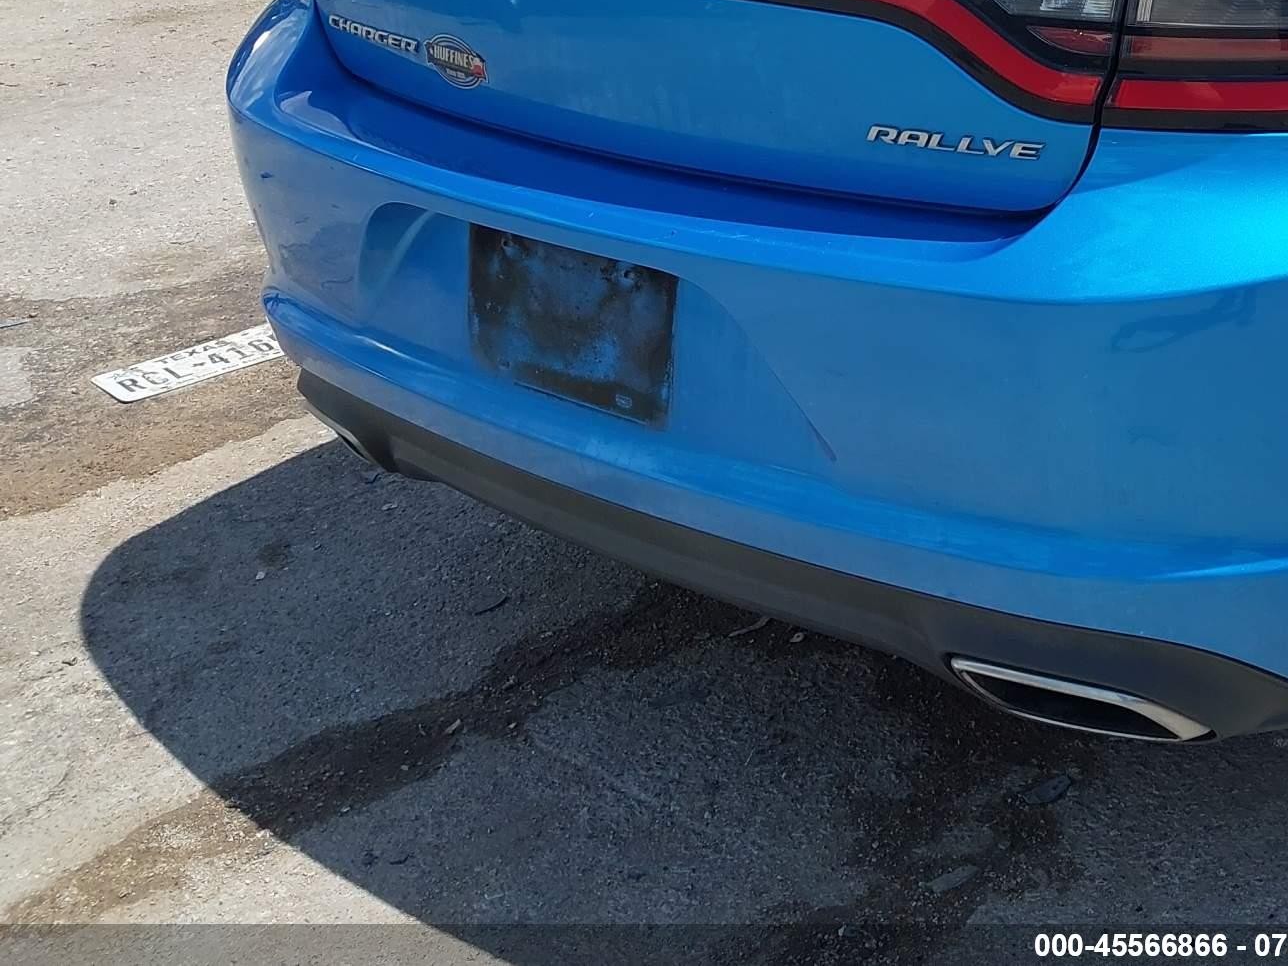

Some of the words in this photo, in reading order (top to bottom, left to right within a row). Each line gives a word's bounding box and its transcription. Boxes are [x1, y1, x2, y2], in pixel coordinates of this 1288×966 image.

[328, 14, 418, 53] CHARGER
[433, 44, 474, 70] HUFFINES
[866, 125, 1046, 161] RALLYE
[154, 339, 234, 365] TEXAS
